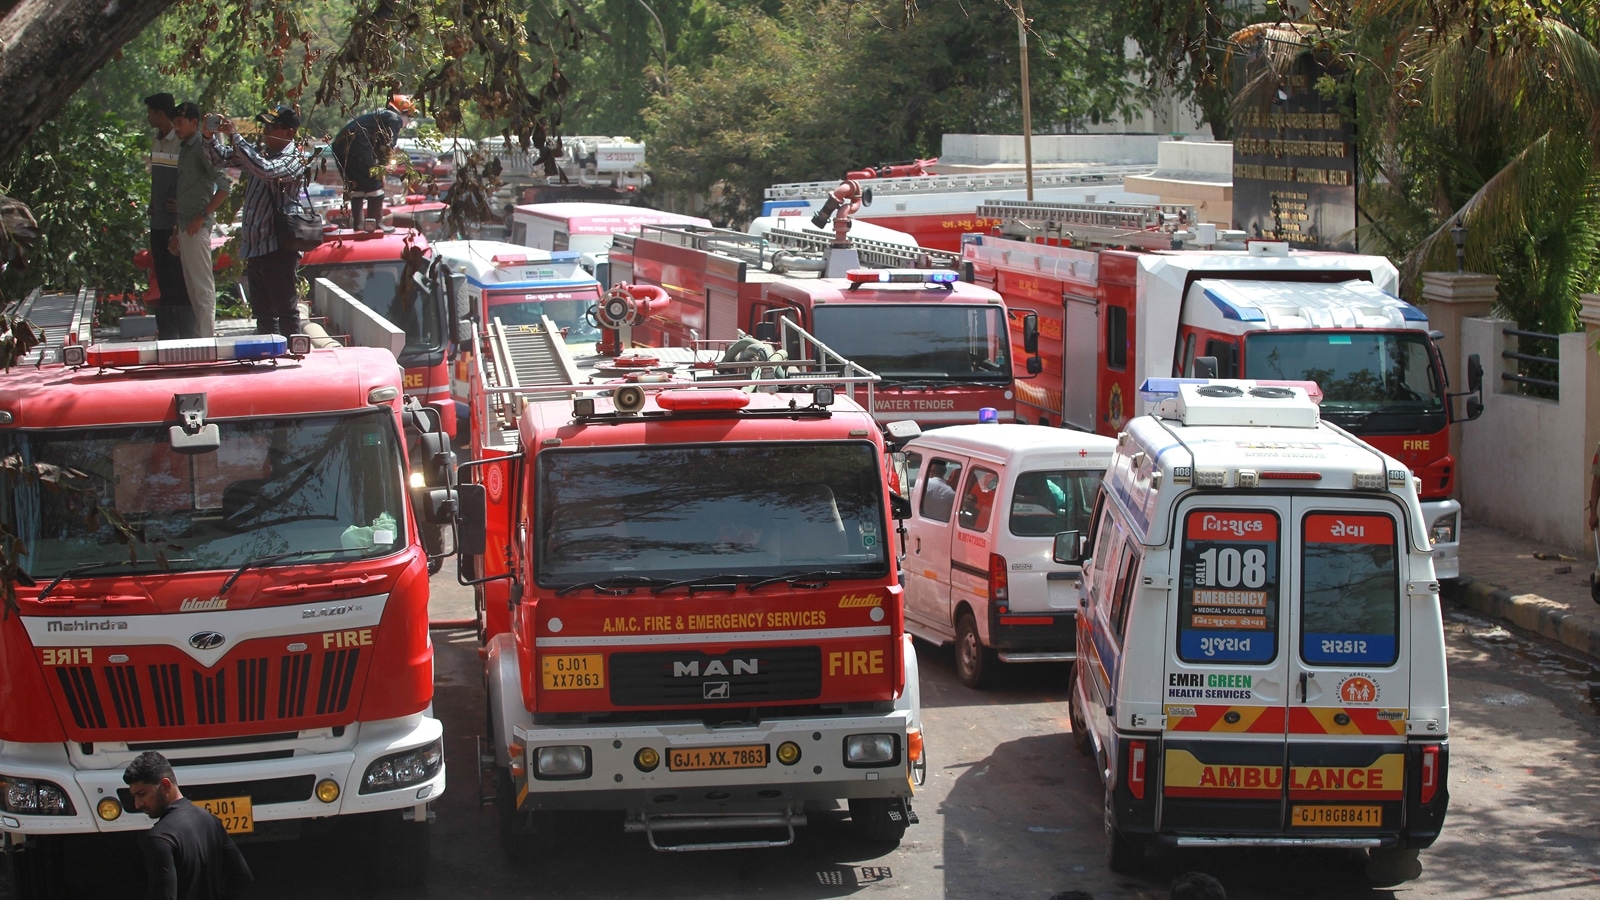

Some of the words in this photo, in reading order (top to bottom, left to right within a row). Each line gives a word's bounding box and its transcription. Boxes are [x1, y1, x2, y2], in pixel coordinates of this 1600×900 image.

[404, 374, 423, 387] RE
[874, 400, 911, 410] WATER
[913, 399, 954, 410] TENDER
[1403, 439, 1430, 451] FIRE
[1175, 467, 1191, 478] 108
[1390, 470, 1406, 480] 108
[1331, 520, 1365, 537] સેવા
[1195, 562, 1206, 585] CALL
[1200, 548, 1266, 588] 108
[1194, 591, 1265, 606] EMERGENCY
[48, 620, 128, 633] Mahindra
[603, 616, 641, 632] A.M.C.
[644, 614, 672, 631] FIRE
[675, 615, 686, 630] &
[688, 611, 765, 630] EMERGENCY
[767, 609, 827, 628] SERVICES
[322, 628, 372, 649] FIRE
[1200, 637, 1251, 657] ગુજરાત
[1321, 640, 1367, 654] સરકાર
[557, 657, 588, 672] GJ01
[673, 658, 759, 677] MAN
[829, 650, 885, 676] FIRE
[552, 673, 599, 688] XX7863
[1169, 673, 1204, 687] EMRI
[1208, 674, 1252, 688] GREEN
[1336, 675, 1348, 703] NATIONAL
[1348, 672, 1372, 680] HEALTH
[1372, 678, 1382, 703] MISSION
[1168, 688, 1203, 698] HEALTH
[1205, 689, 1251, 699] SERVICES
[732, 749, 764, 765] 7863
[1200, 766, 1384, 790] AMBULANCE
[204, 800, 236, 816] GJ01
[1302, 811, 1379, 824] GJ18GB8411
